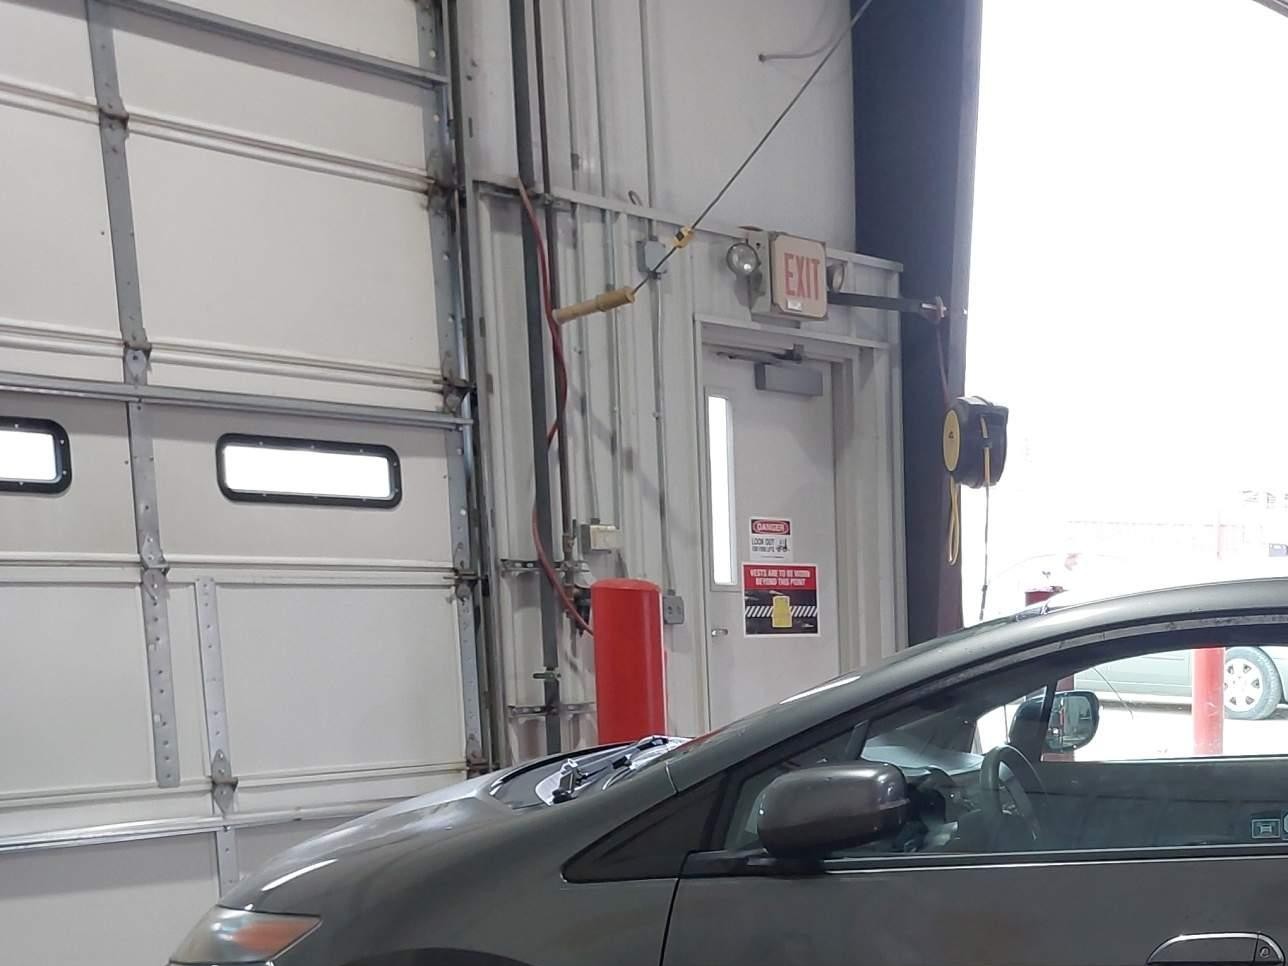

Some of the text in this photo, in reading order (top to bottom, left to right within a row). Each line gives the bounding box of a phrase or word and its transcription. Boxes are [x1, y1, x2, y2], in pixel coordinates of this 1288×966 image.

[783, 252, 821, 300] EXIT
[757, 523, 784, 532] DANGER
[750, 569, 767, 577] VESTS
[768, 569, 778, 577] ARE
[778, 569, 786, 577] TO
[755, 578, 806, 586] BEYOND THIS POINT
